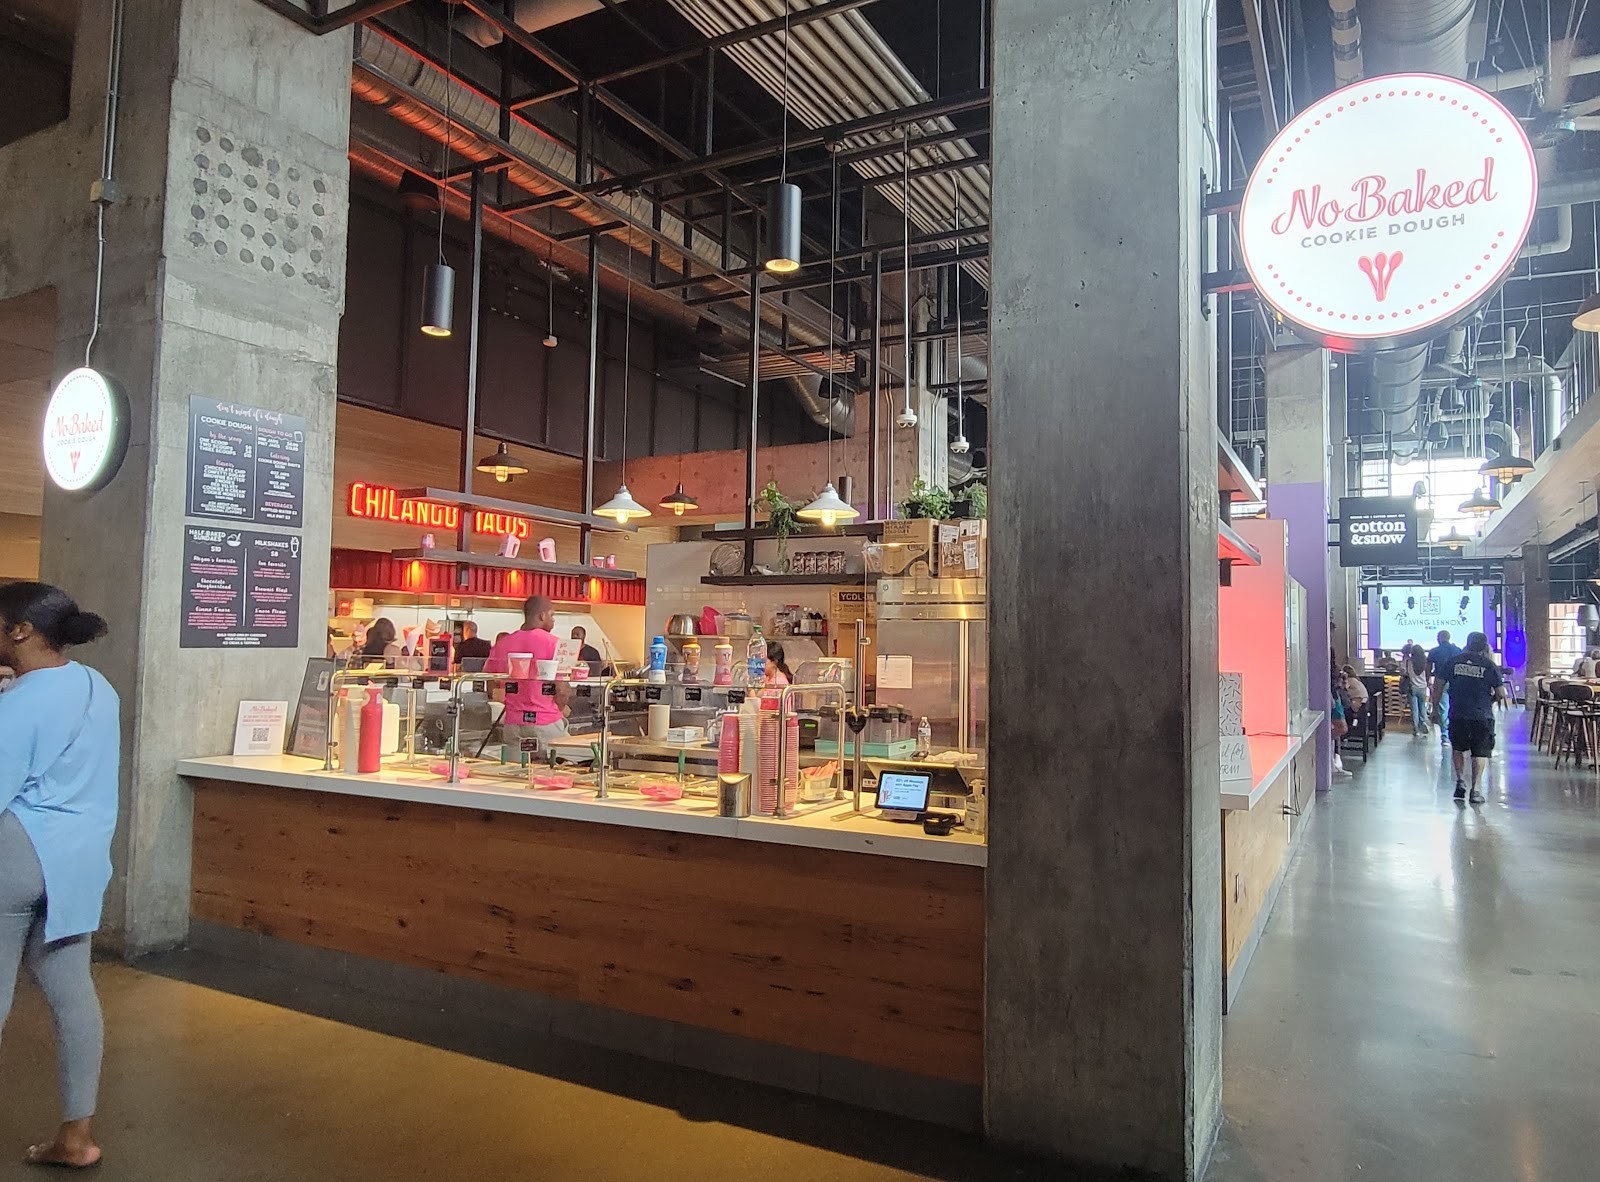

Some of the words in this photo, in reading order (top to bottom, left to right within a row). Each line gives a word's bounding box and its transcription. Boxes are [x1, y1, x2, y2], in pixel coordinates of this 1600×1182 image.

[1300, 226, 1378, 249] COOKIE
[1387, 213, 1466, 237] DOUGH
[201, 416, 227, 426] COOKIE
[228, 421, 253, 430] DOUGH
[57, 438, 76, 446] COOKIE
[78, 436, 96, 445] DOUGH
[265, 501, 293, 509] BEVERAGES
[1350, 520, 1407, 533] cotton
[193, 534, 221, 542] SUNDAES
[255, 540, 289, 548] MILKSHAKES
